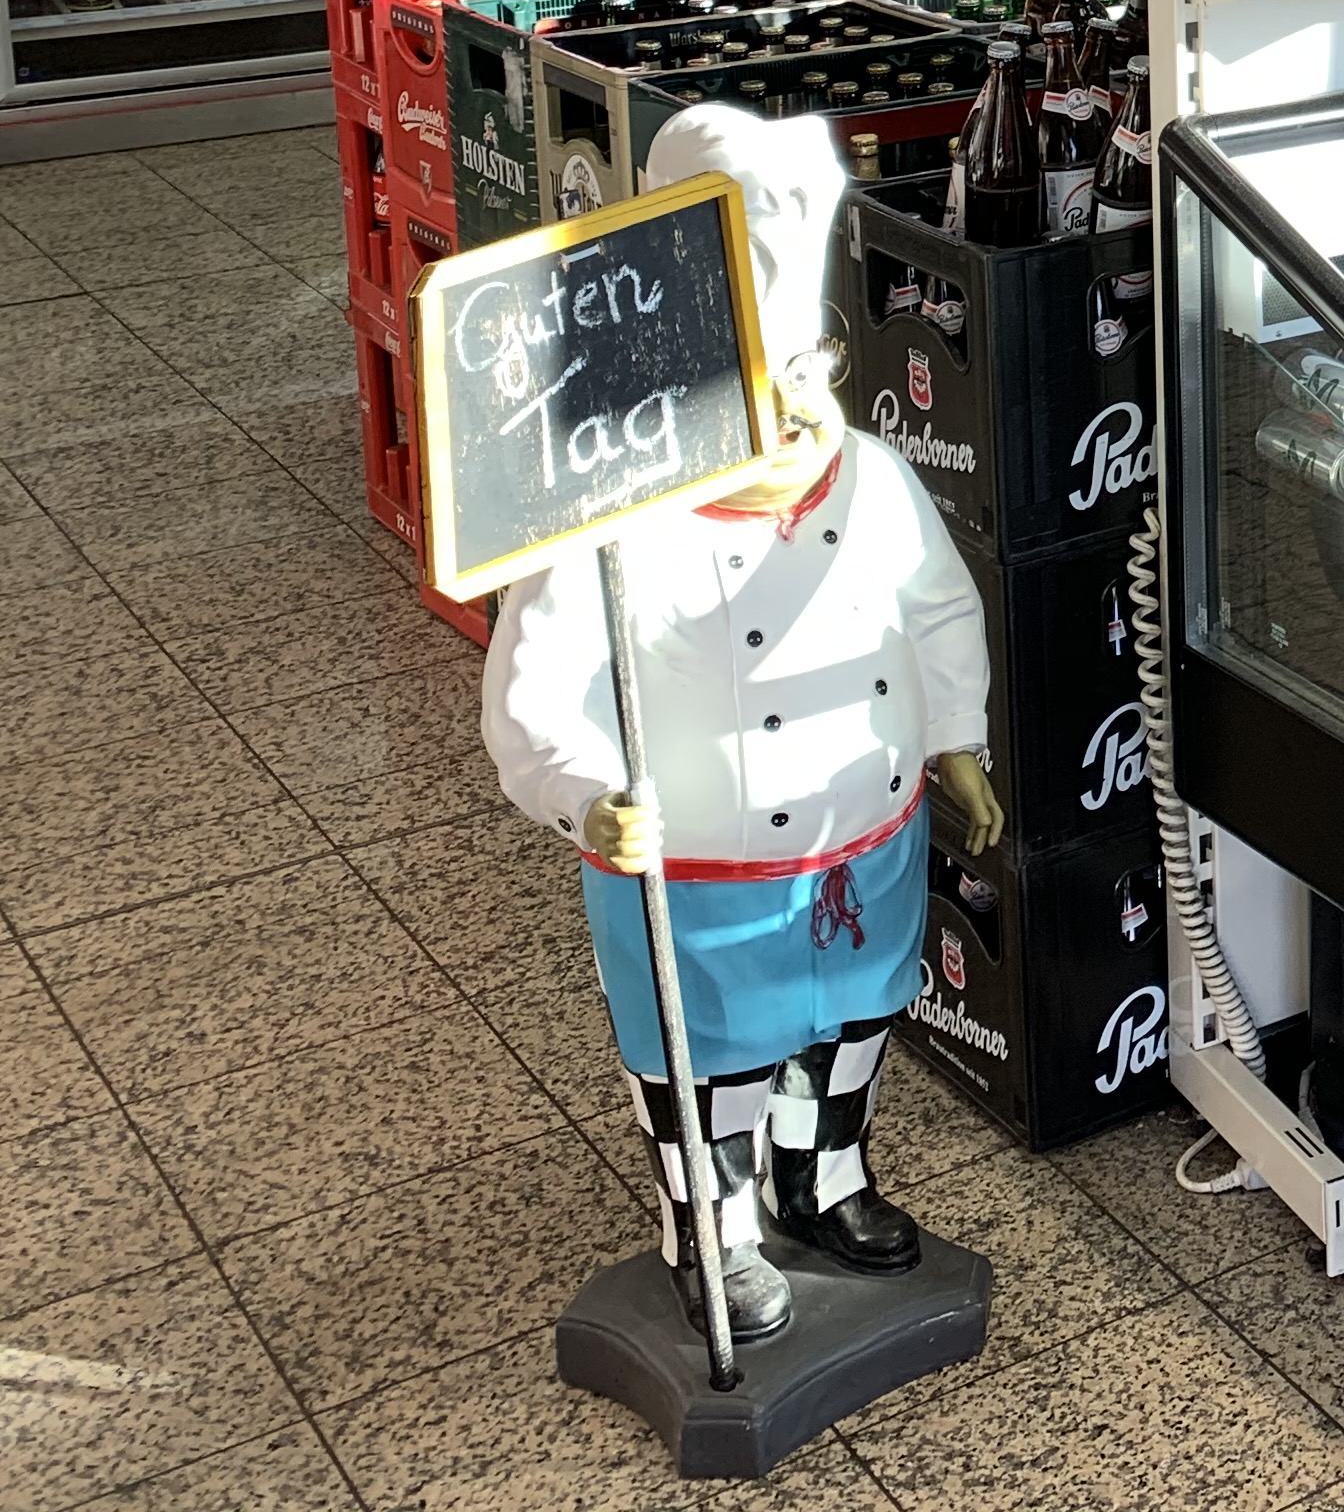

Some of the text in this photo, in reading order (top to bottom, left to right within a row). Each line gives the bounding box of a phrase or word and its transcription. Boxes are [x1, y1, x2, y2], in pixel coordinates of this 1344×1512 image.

[391, 8, 436, 36] ORIGINAL
[361, 74, 371, 90] 12
[397, 90, 448, 135] Budweiser
[461, 134, 526, 197] HOLSTEN
[1064, 206, 1089, 232] Pad
[450, 263, 663, 388] Guten
[500, 356, 688, 512] Tag
[871, 388, 977, 474] Paderborner
[1069, 401, 1158, 511] Pad
[395, 514, 405, 531] 12
